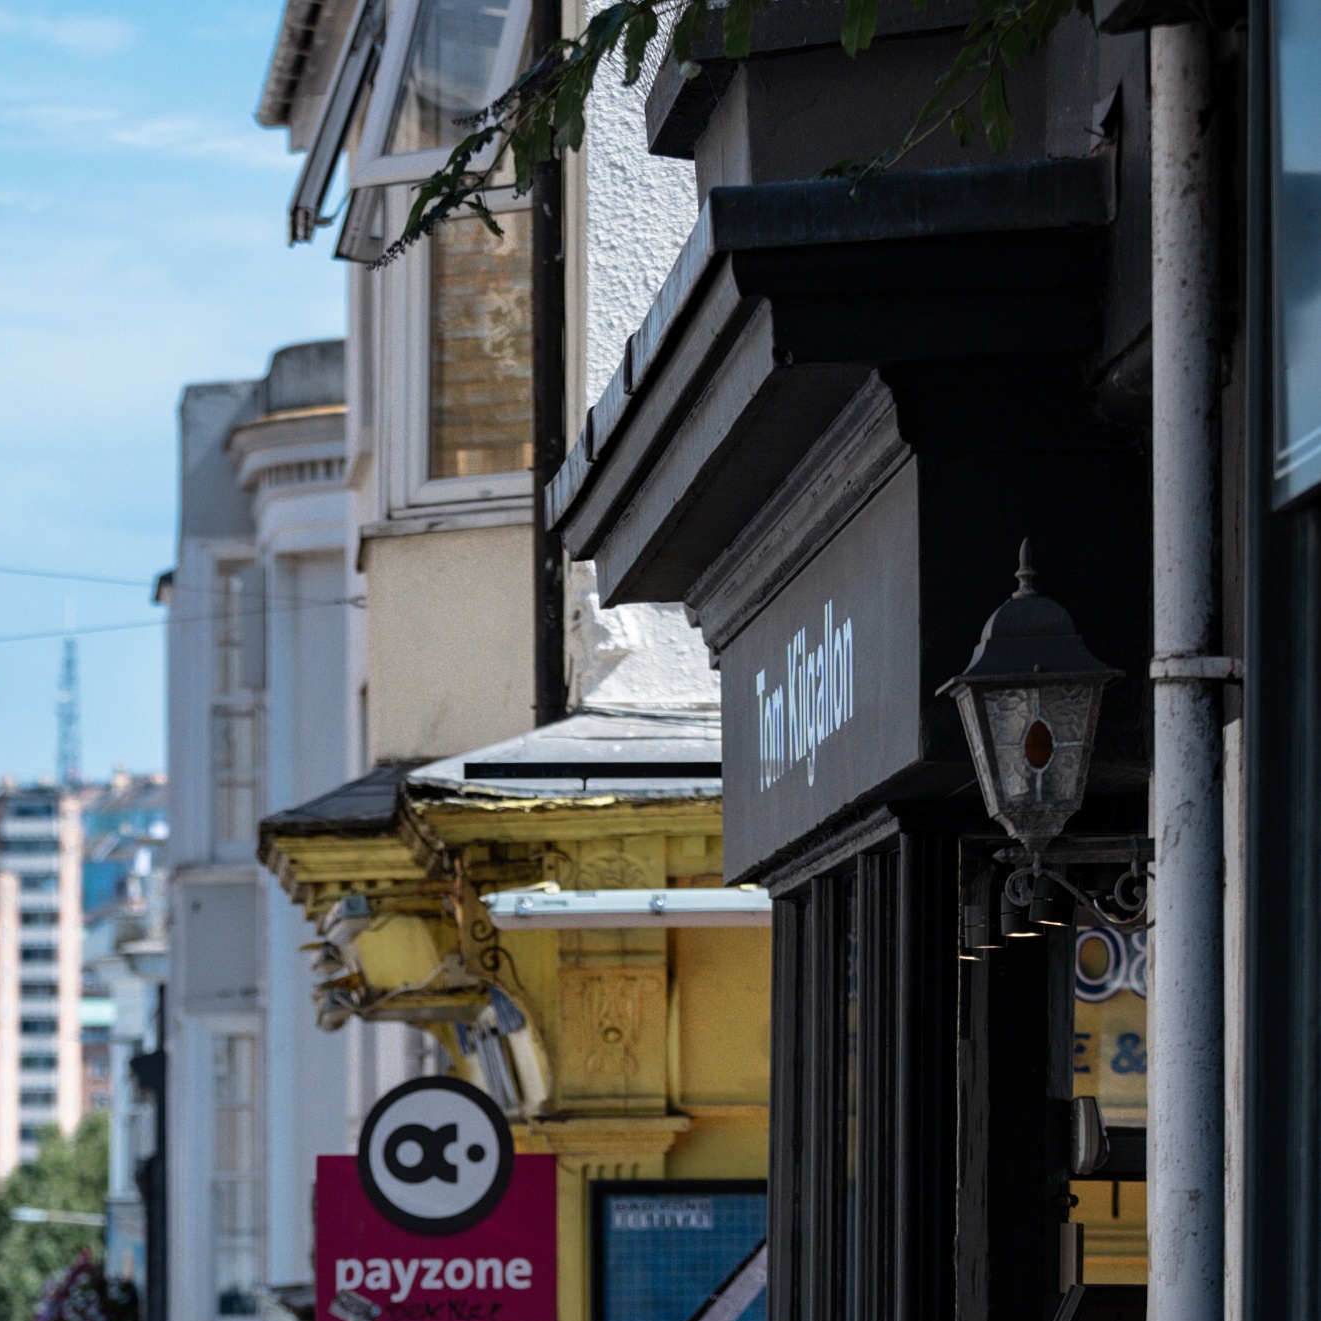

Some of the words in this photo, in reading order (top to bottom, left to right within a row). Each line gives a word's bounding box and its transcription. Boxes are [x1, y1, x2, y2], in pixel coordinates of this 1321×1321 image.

[756, 668, 785, 793] Tom
[787, 599, 853, 787] Kilgallon
[614, 1213, 713, 1228] FESTIVAL
[335, 1257, 533, 1303] payzone
